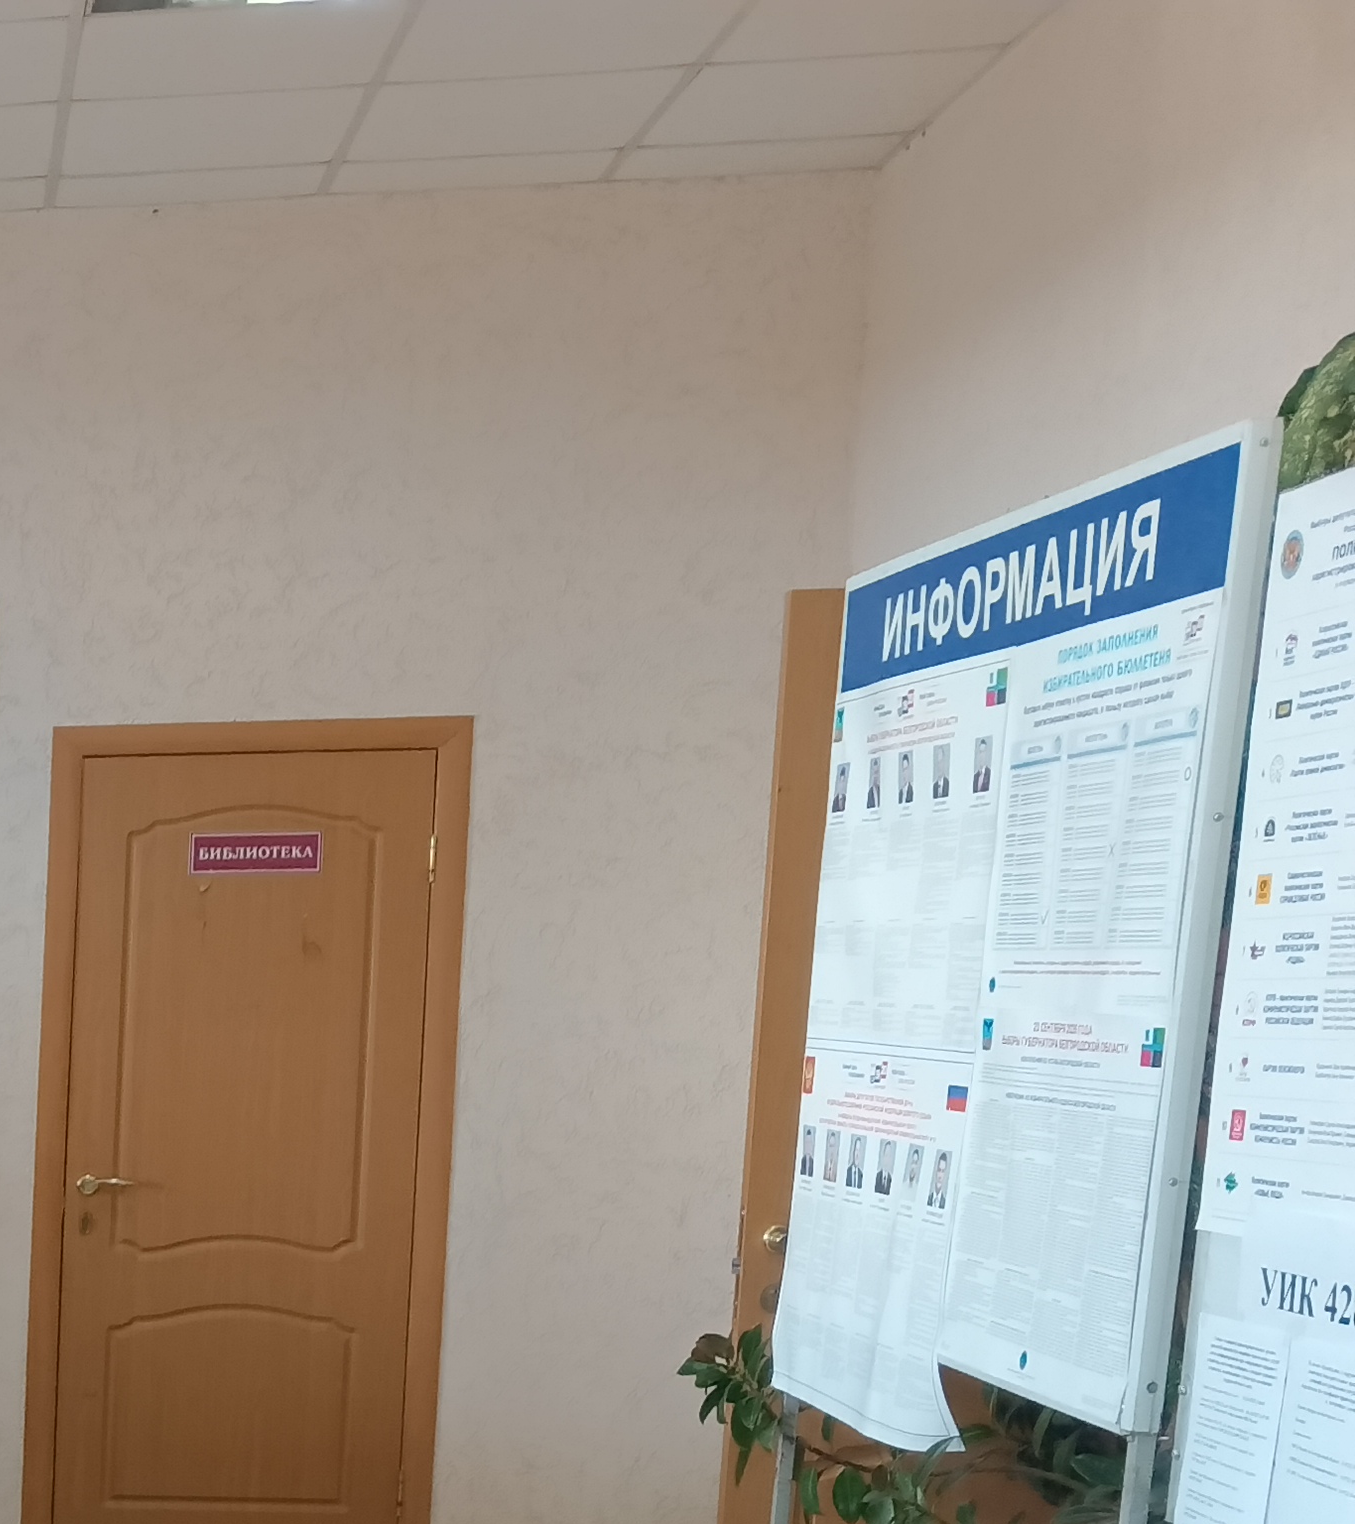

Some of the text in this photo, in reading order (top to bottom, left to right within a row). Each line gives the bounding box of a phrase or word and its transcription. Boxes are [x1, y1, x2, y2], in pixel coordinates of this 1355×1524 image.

[881, 498, 1162, 662] ИНФОРМАЦИЯ
[1096, 624, 1159, 655] ЗАПОЛНЕНИЯ
[199, 845, 314, 860] БИБЛИОТЕКА
[1261, 1267, 1355, 1326] УИК 42
